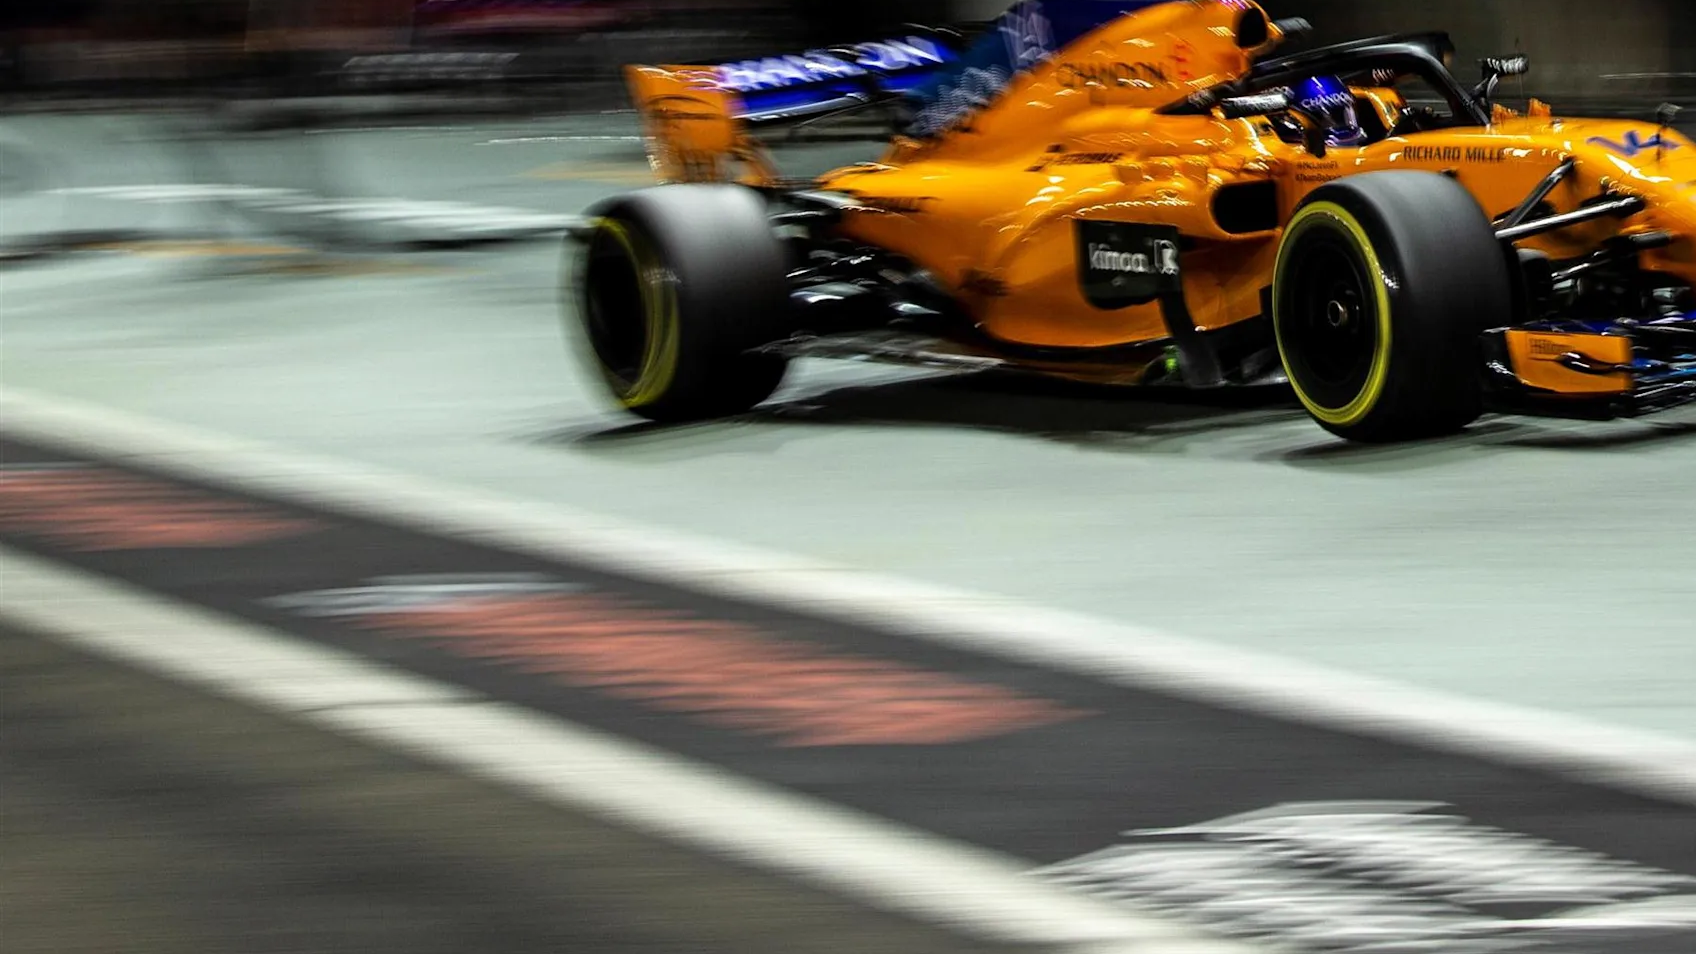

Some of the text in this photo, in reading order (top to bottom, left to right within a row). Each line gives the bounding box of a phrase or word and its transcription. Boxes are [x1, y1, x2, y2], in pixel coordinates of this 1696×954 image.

[1302, 91, 1355, 109] CHANDON
[1403, 146, 1504, 163] RICHARD MILLE
